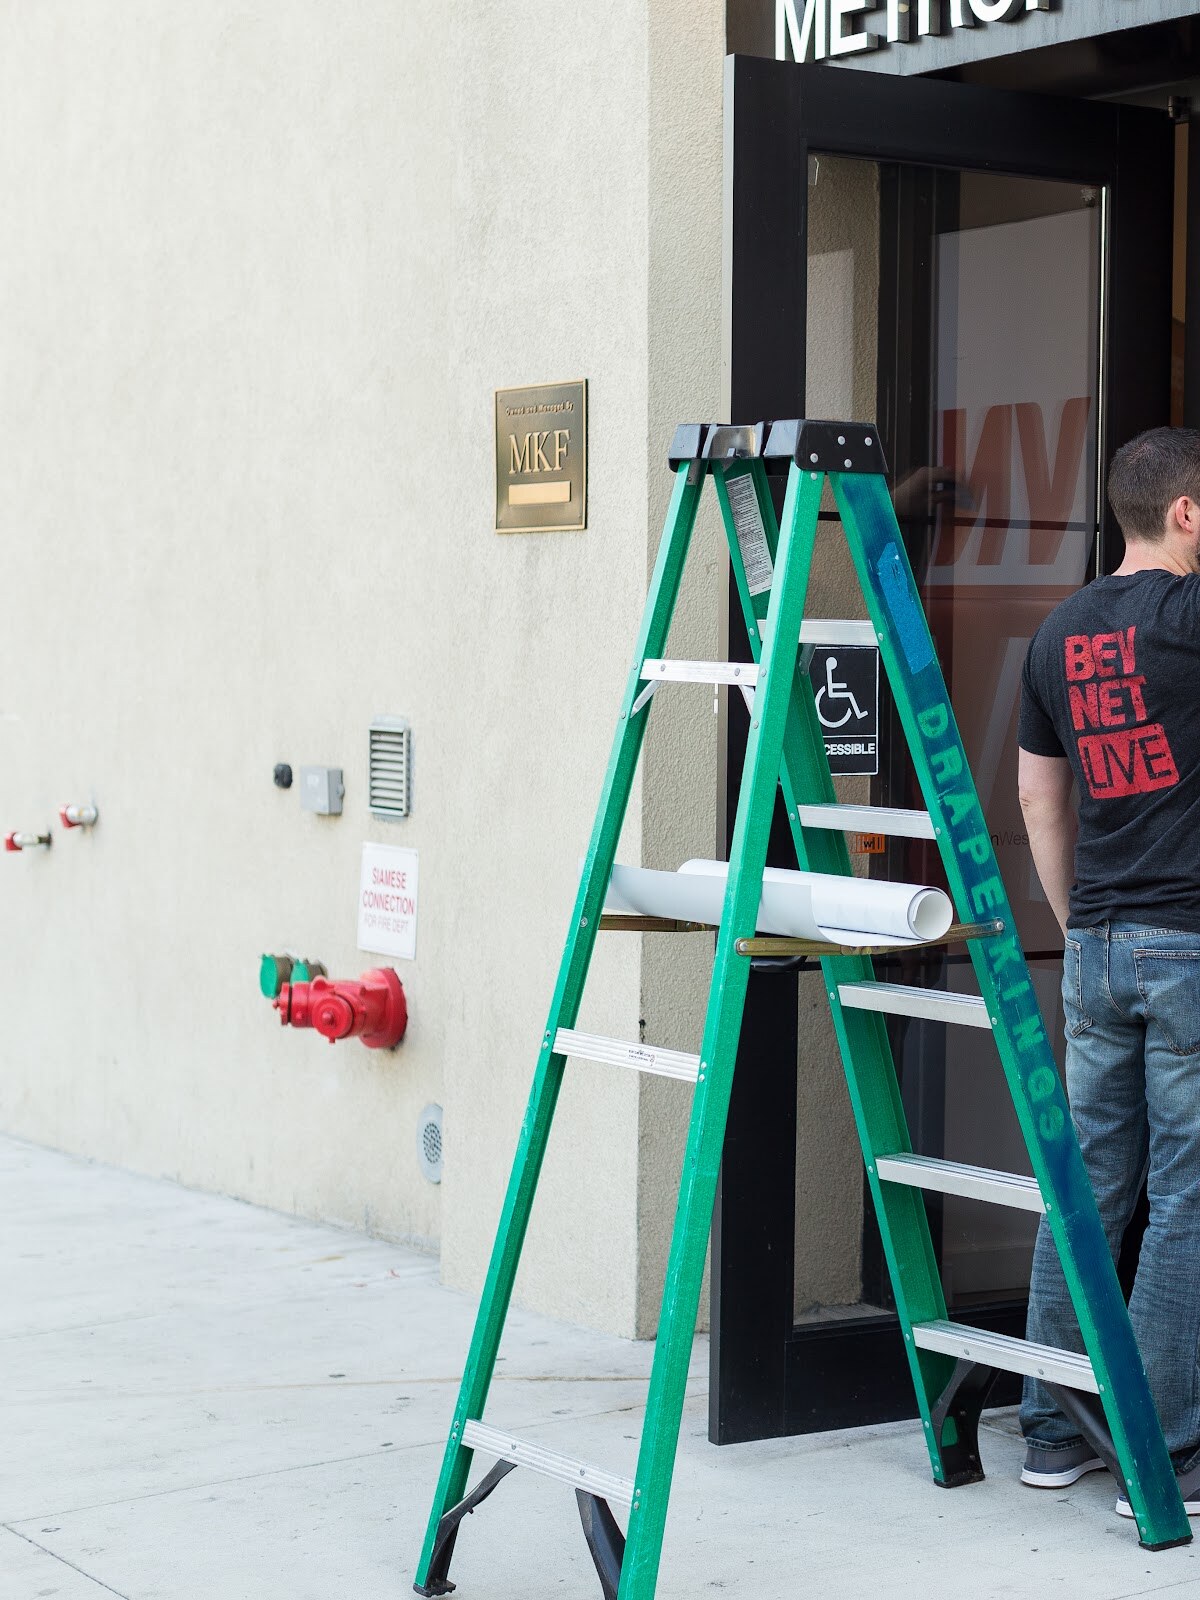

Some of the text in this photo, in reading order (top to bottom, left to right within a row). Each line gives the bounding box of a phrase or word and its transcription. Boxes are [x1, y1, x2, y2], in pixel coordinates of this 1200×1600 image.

[538, 402, 565, 413] Managed
[565, 400, 574, 412] By
[509, 429, 570, 474] MKF
[1068, 675, 1147, 730] NET
[824, 743, 876, 756] CESSIBLE
[1083, 733, 1172, 789] LIVE
[372, 867, 407, 889] SIAMESE
[362, 890, 415, 915] CONNECTION
[364, 914, 377, 928] FOR
